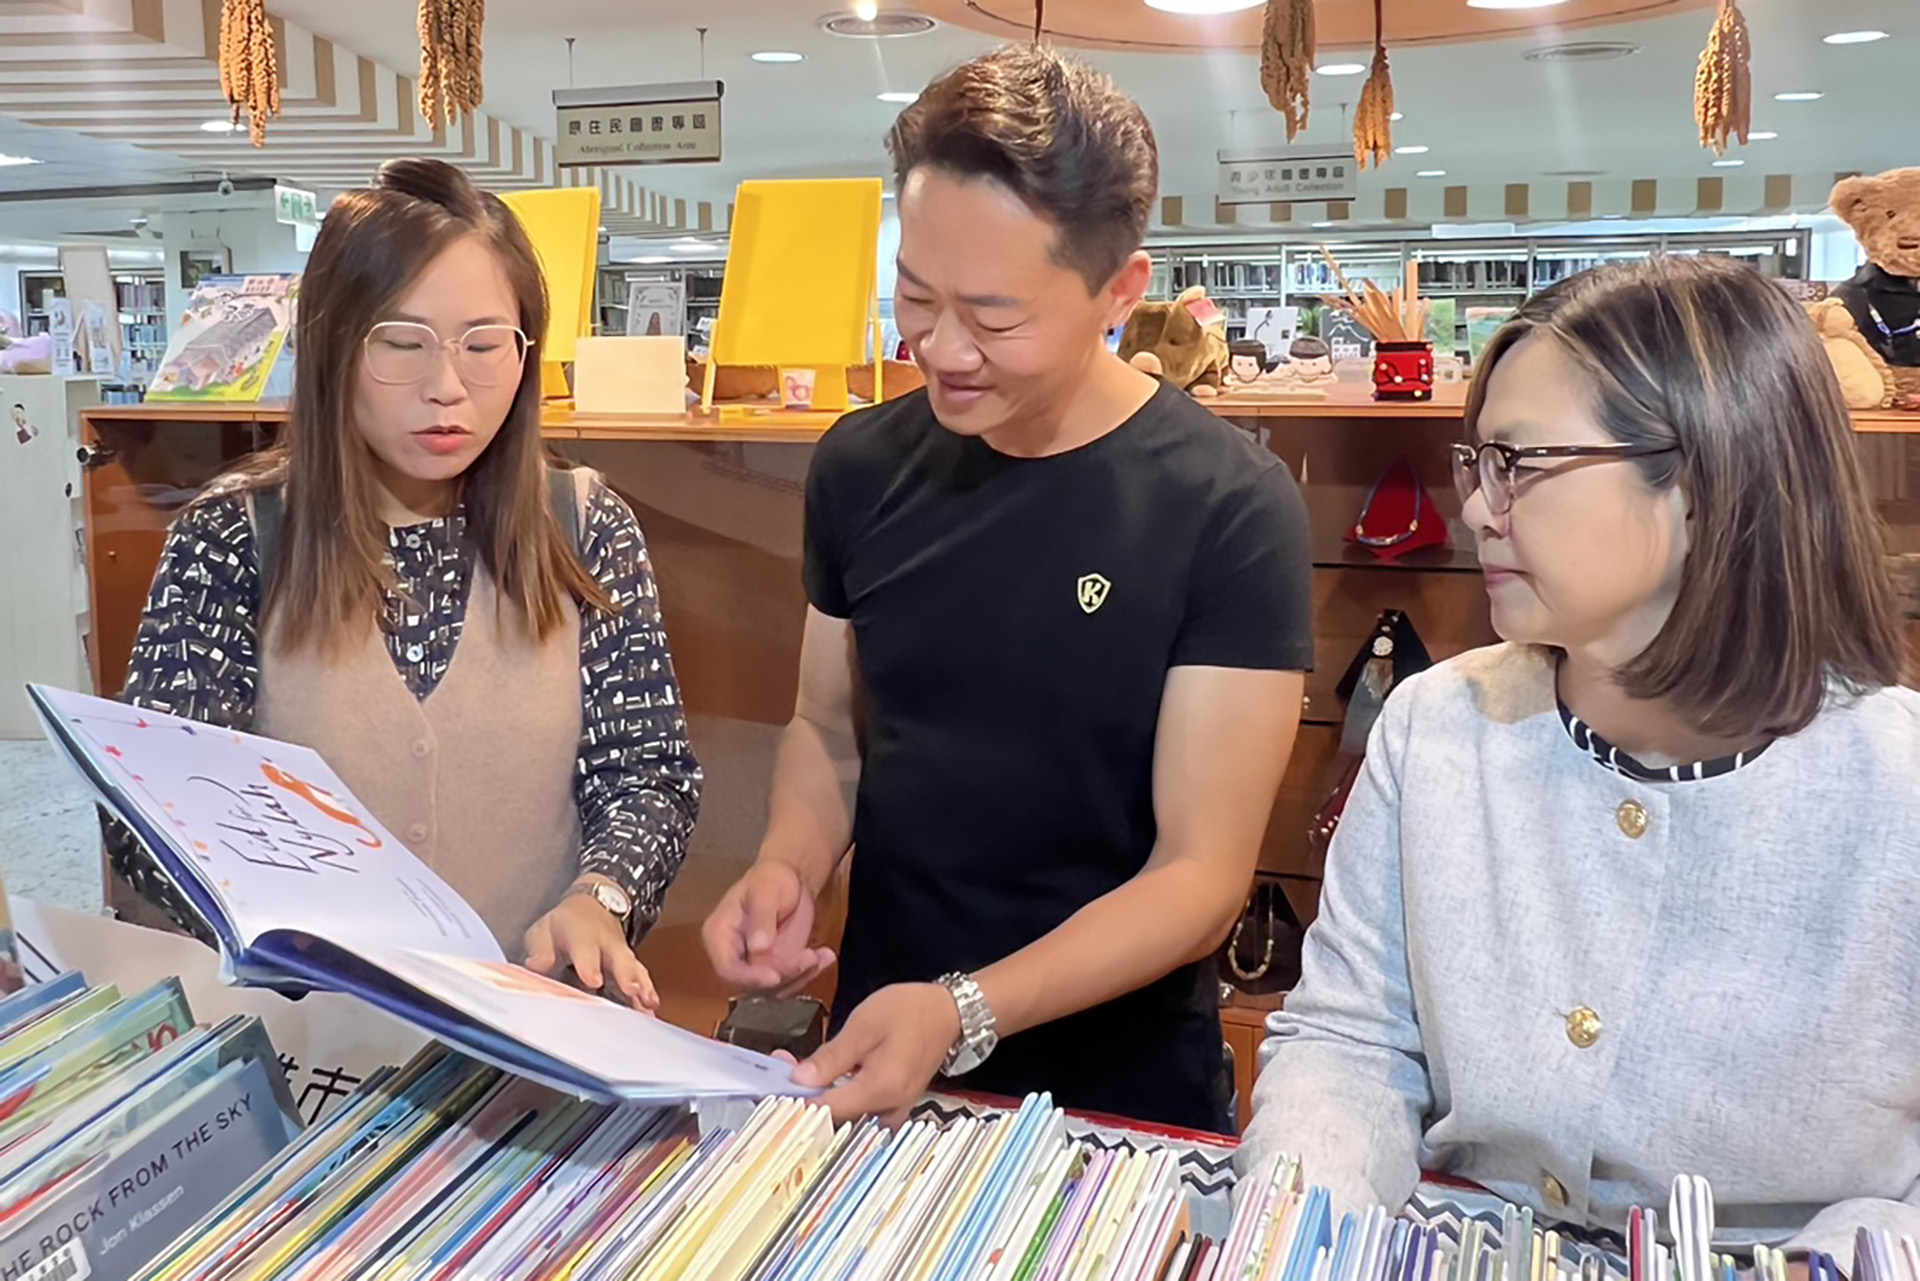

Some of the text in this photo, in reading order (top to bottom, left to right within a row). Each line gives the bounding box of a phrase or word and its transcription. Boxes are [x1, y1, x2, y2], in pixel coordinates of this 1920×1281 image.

[569, 114, 706, 135] 原住民圖書專區
[627, 141, 671, 152] Collection
[677, 140, 696, 150] Area
[1231, 167, 1345, 183] 青少年圖書專區
[1265, 184, 1291, 193] Adult
[1296, 182, 1345, 192] Collection
[216, 822, 318, 874] Eid
[240, 783, 360, 873] Nylah
[279, 1053, 362, 1126] 市
[0, 1249, 35, 1281] HE
[39, 1198, 105, 1258] ROCK
[109, 1152, 170, 1209] FROM
[172, 1123, 213, 1160] THE
[217, 1092, 253, 1130] SKY
[99, 1185, 184, 1255] Jon Klassen
